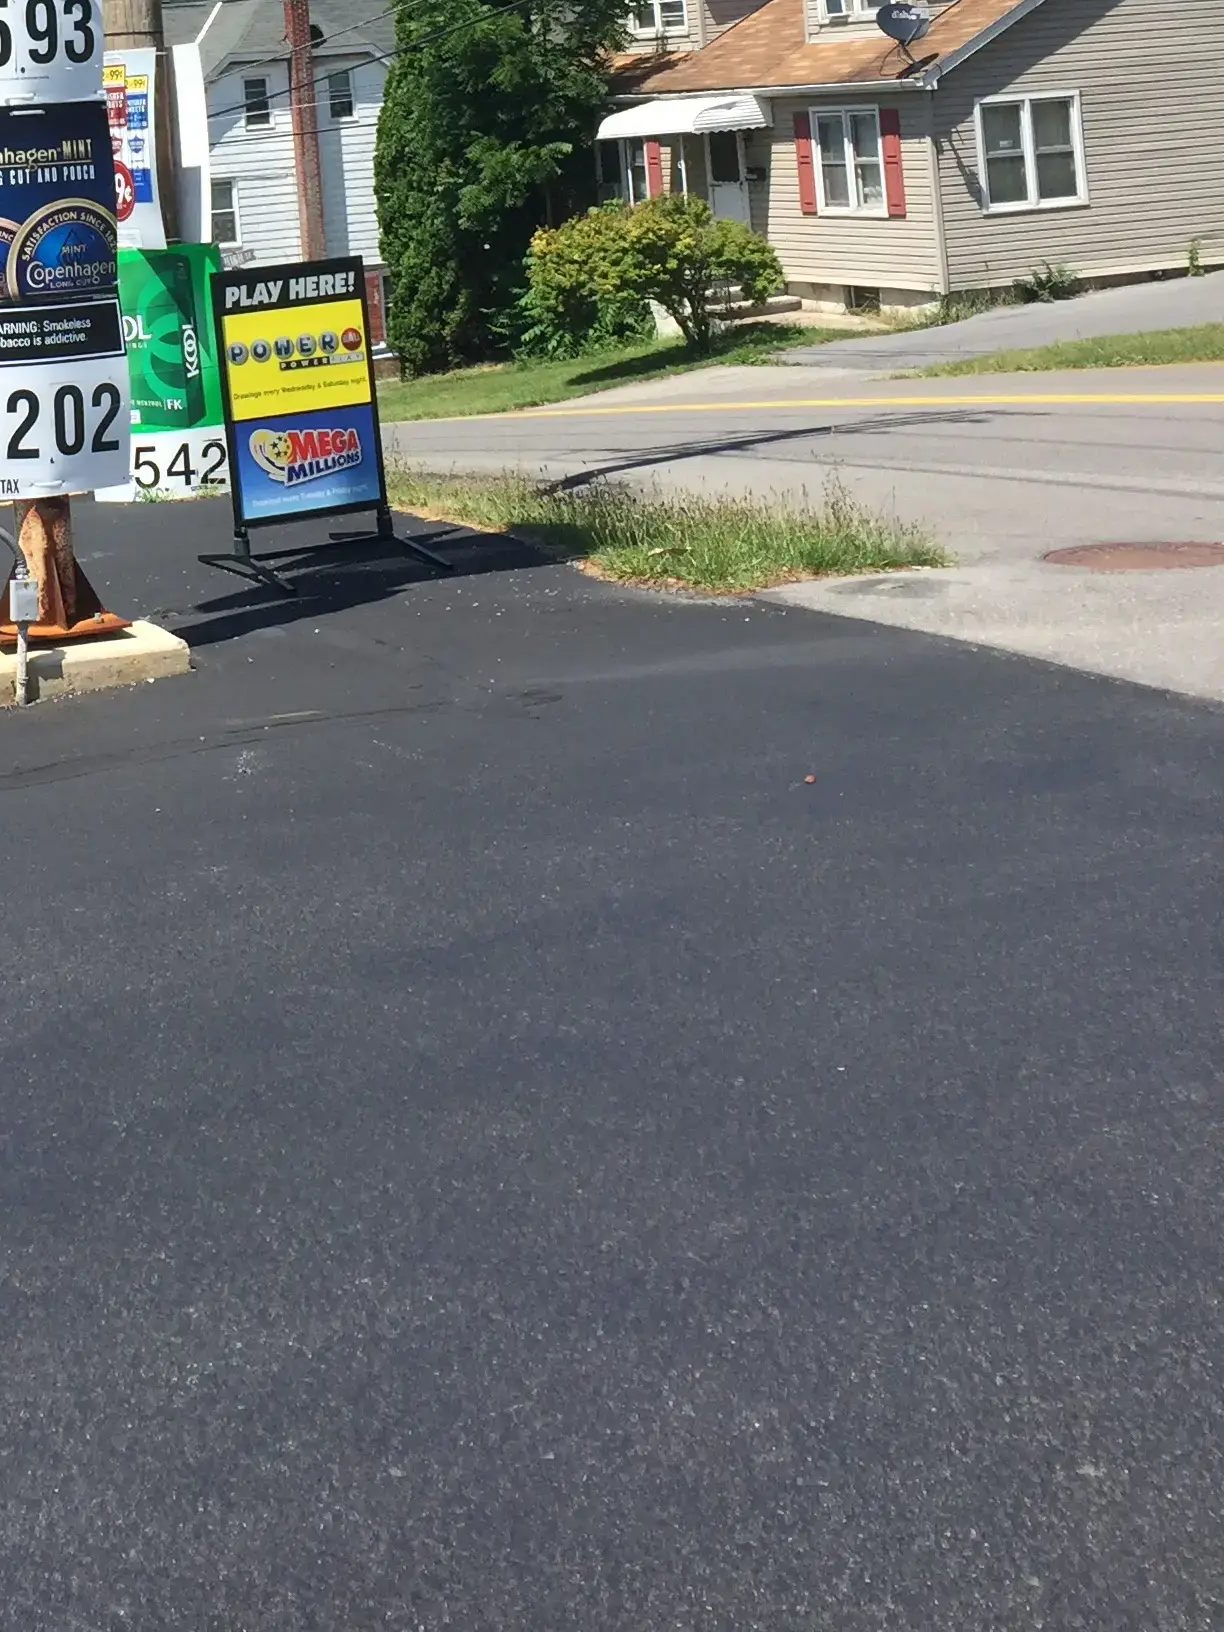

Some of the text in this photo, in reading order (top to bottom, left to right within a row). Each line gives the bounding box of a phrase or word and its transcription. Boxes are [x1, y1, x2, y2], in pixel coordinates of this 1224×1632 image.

[62, 139, 92, 160] MINT
[9, 169, 30, 186] CUT
[37, 167, 57, 184] AND
[63, 164, 95, 182] POUCH
[22, 211, 78, 261] SATISFACTION
[80, 212, 106, 232] SINCE
[61, 243, 88, 254] MINT
[26, 259, 116, 289] Copenhagen
[225, 271, 355, 309] PLAY HERE!
[43, 317, 92, 332] Smokeless
[33, 334, 42, 345] is
[182, 317, 199, 379] KOOL
[287, 430, 359, 464] MEGA
[287, 450, 361, 483] MILLIONS
[0, 479, 19, 494] TAX
